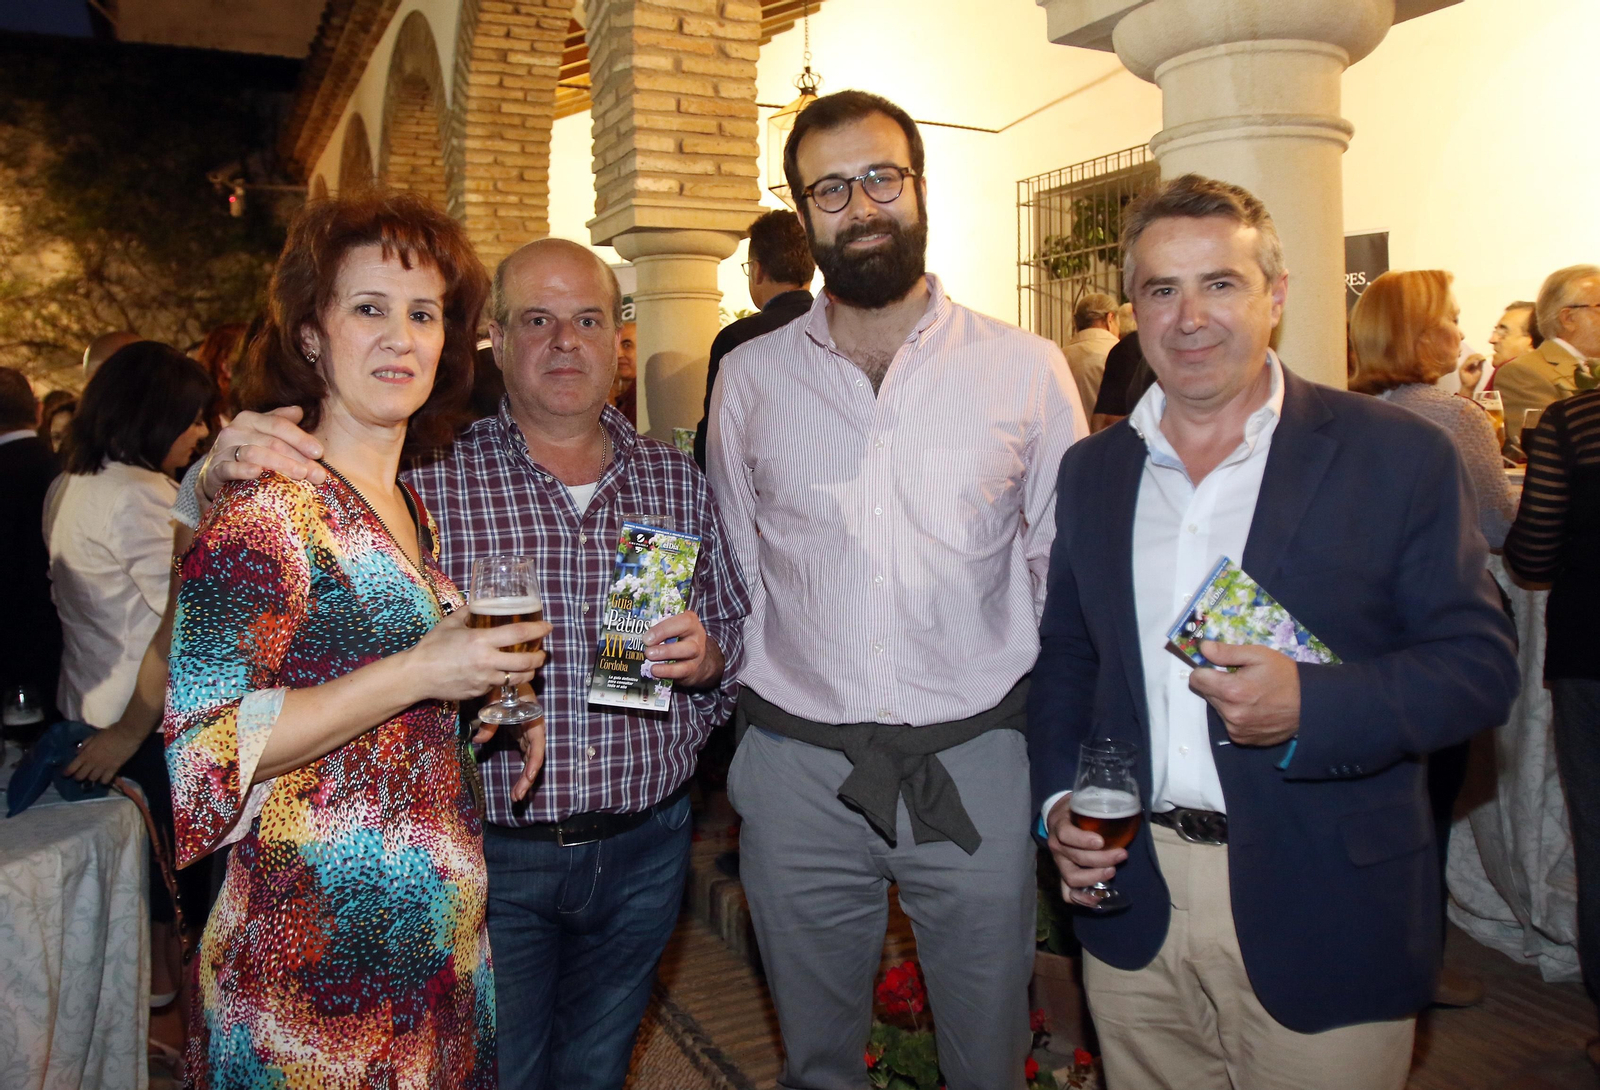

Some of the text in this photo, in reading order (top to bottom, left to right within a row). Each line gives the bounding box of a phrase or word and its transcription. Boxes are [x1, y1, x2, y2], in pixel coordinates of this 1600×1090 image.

[611, 593, 632, 609] Guía
[607, 609, 651, 634] Patios
[601, 633, 628, 658] XIV
[599, 658, 629, 672] Córdoba
